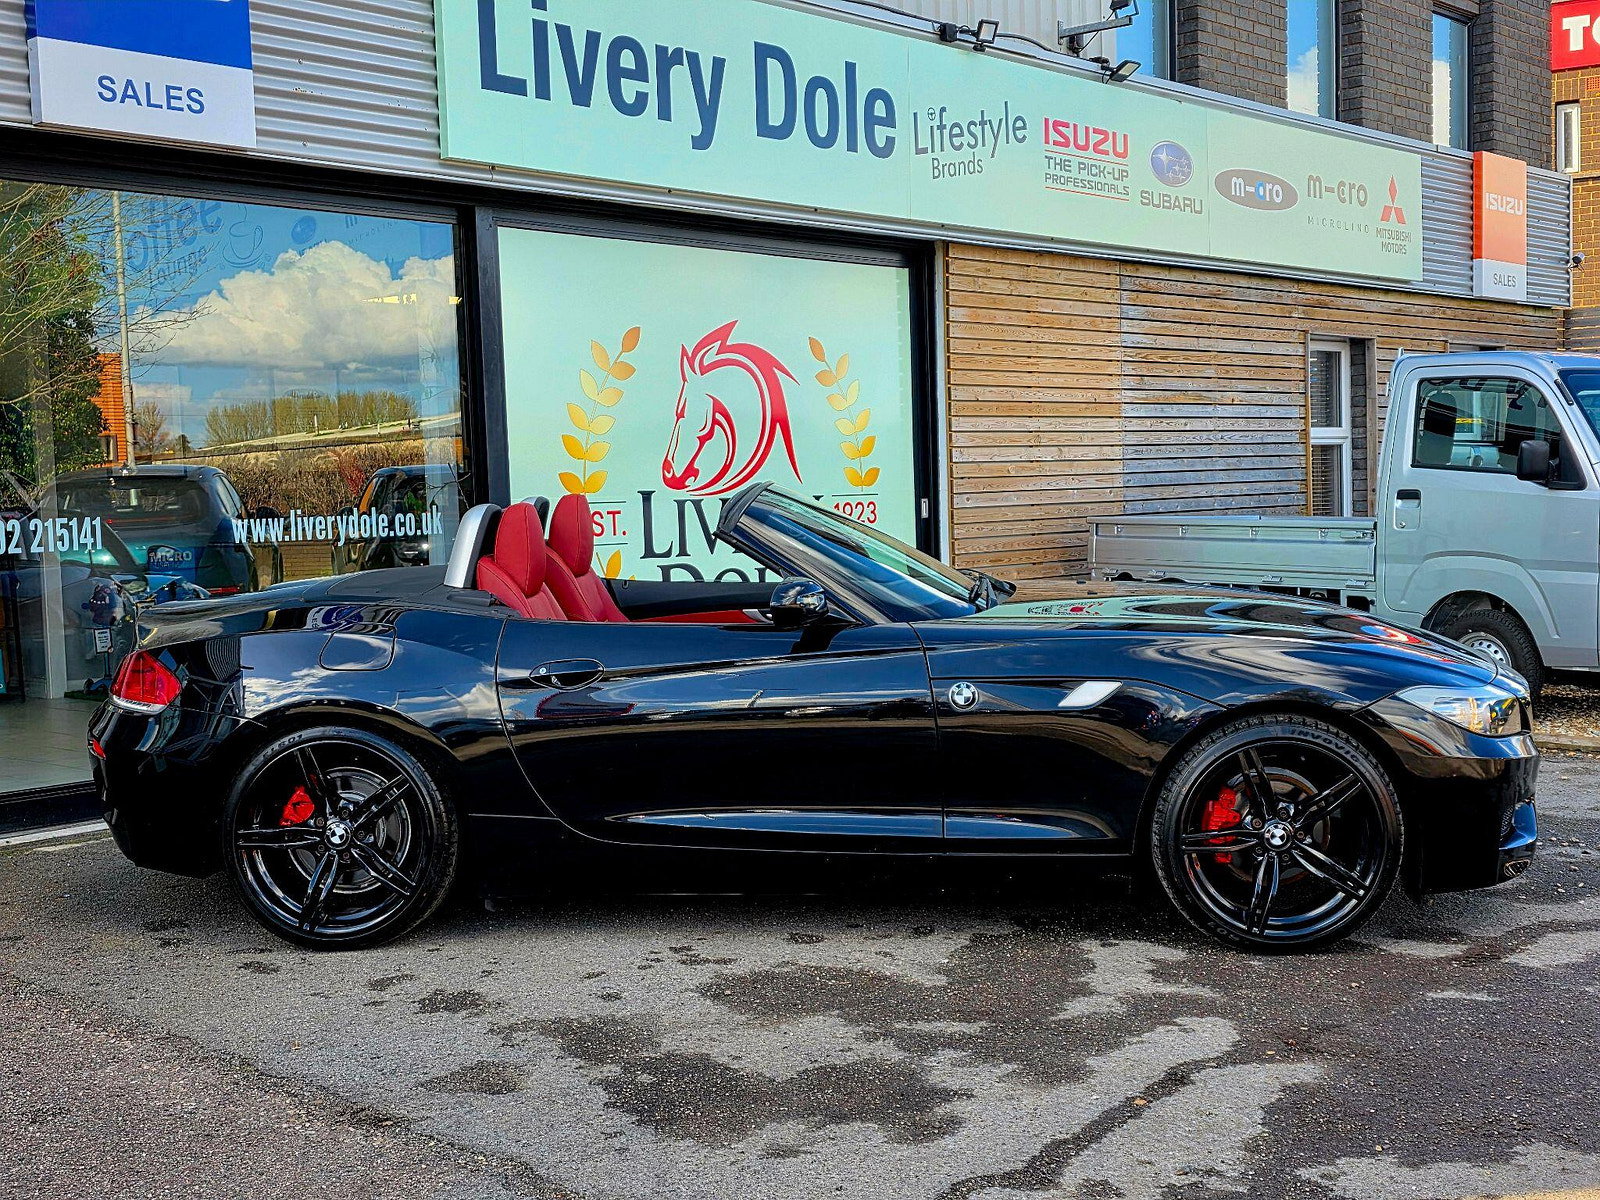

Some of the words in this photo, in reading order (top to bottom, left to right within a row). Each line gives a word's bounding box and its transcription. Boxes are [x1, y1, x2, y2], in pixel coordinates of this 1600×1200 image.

[477, 0, 726, 151] Livery
[754, 40, 897, 160] Dole
[97, 75, 205, 115] SALES
[913, 101, 1028, 159] Lifestyle
[1043, 117, 1130, 160] ISUZU
[931, 152, 984, 179] Brands
[1044, 155, 1072, 174] THE
[1078, 158, 1130, 181] PICK-UP
[1044, 173, 1130, 196] PROFESSIONALS
[1139, 189, 1203, 215] SUBARU
[1485, 192, 1524, 216] ISUZU
[1307, 215, 1370, 234] MICROLINO
[1375, 227, 1412, 243] MITSUBISHI
[1381, 241, 1407, 255] MOTORS
[1492, 273, 1517, 288] SALES
[29, 516, 103, 553] 215141
[231, 504, 443, 547] www.liverydole.co.uk
[592, 509, 627, 537] ST.
[637, 490, 742, 560] LIV
